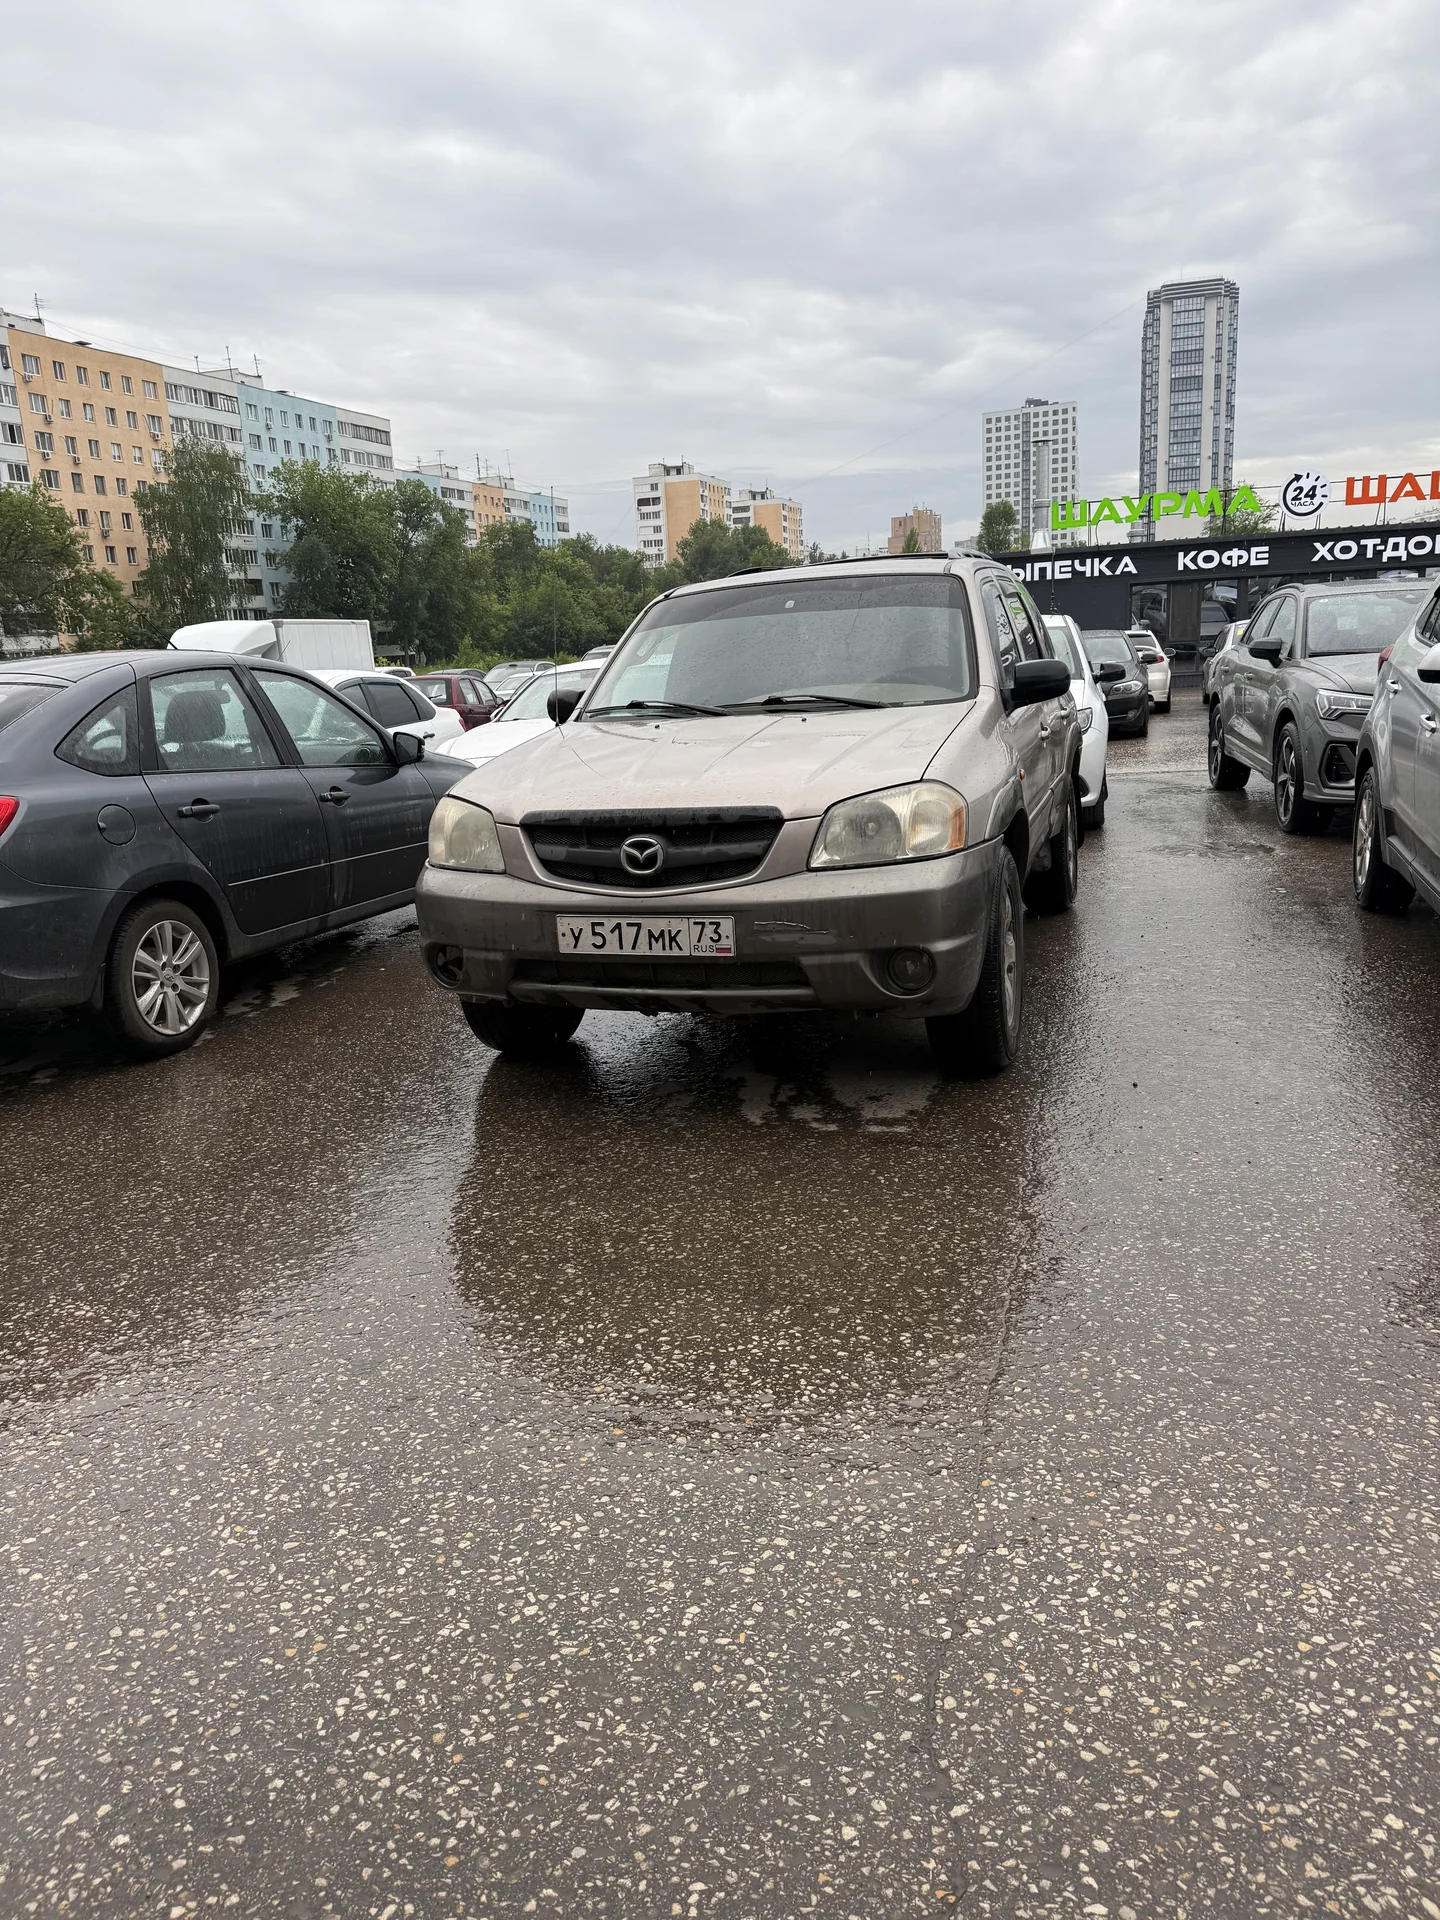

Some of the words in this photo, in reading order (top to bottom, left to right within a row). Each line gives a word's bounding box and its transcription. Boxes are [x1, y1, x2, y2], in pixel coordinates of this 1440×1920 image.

[1291, 485, 1317, 501] 24
[1051, 485, 1262, 529] ШАУРМА
[1006, 555, 1138, 582] ЫПЕЧКА
[1178, 546, 1270, 571] КОФЕ
[693, 944, 715, 953] RUS
